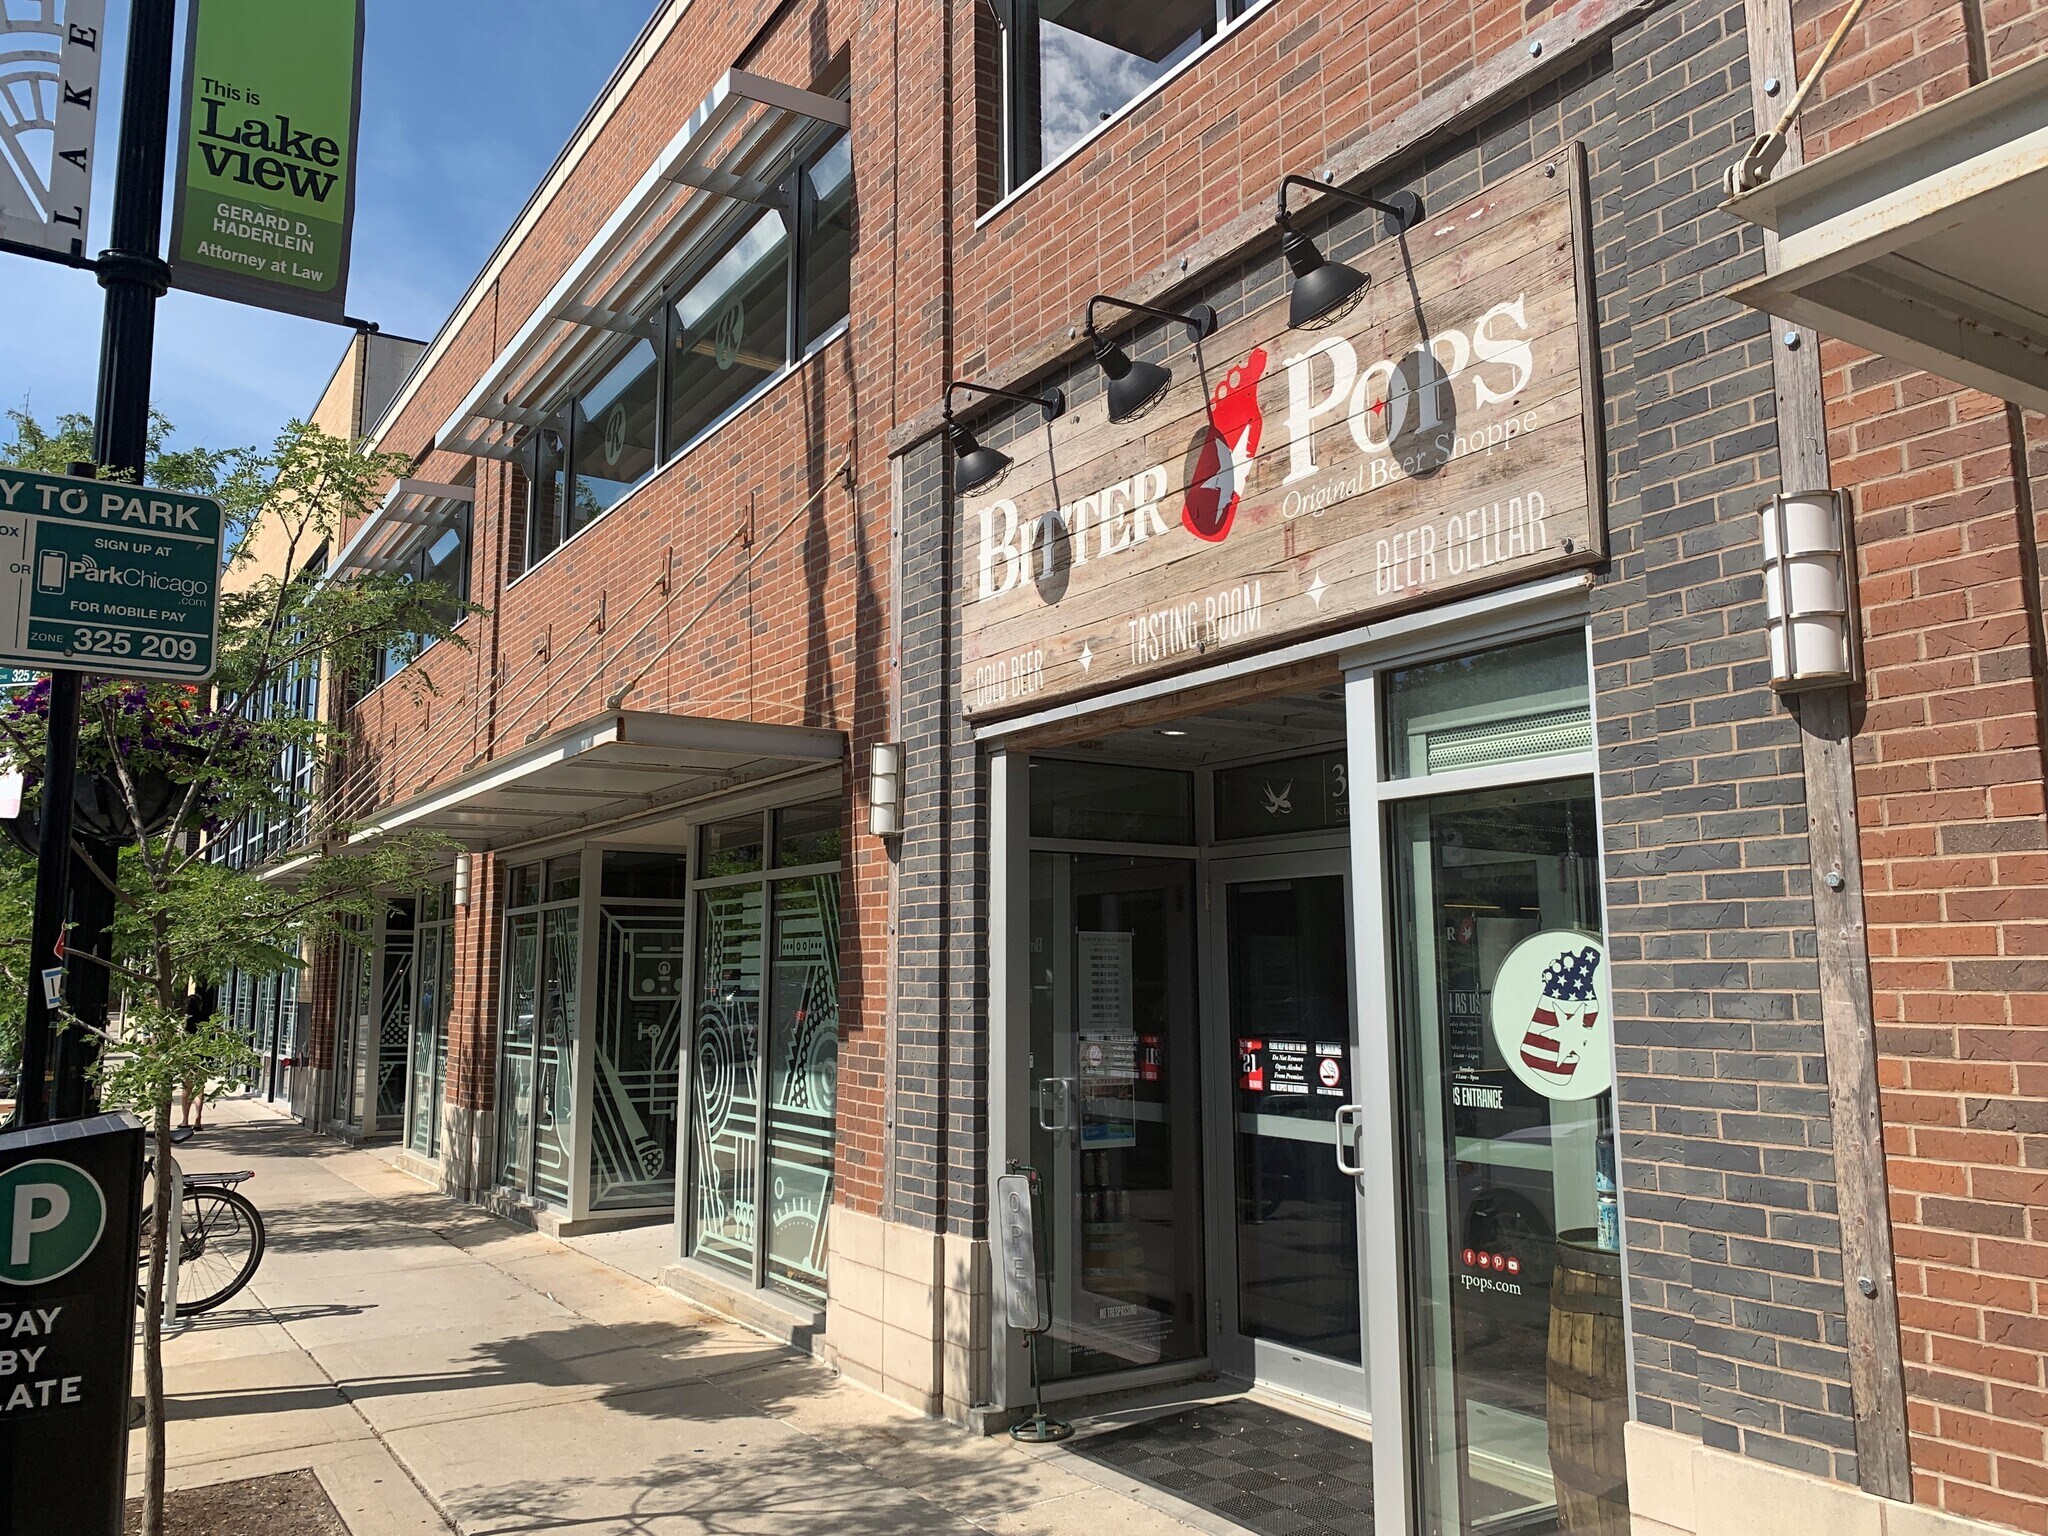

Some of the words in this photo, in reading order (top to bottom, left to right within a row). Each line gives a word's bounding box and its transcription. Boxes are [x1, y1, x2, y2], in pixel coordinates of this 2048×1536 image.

[201, 77, 241, 101] This
[246, 88, 260, 105] is
[199, 97, 339, 167] Lake
[198, 142, 338, 202] view
[213, 218, 314, 254] HADERLEIN
[216, 203, 289, 232] GERARD
[295, 222, 312, 238] D.
[198, 241, 266, 271] Attorney
[271, 259, 286, 274] at
[292, 263, 323, 282] Law
[977, 465, 1171, 604] BITTER
[1281, 293, 1534, 486] POPS
[1282, 475, 1364, 518] Original
[1370, 450, 1427, 489] Beer
[1435, 410, 1539, 466] Shoppe
[35, 484, 88, 514] TO
[100, 494, 200, 531] PARK
[94, 538, 129, 552] SIGN
[132, 543, 152, 554] UP
[155, 547, 172, 557] AT
[1376, 524, 1436, 596] BEER
[1447, 491, 1547, 576] CELLAR
[10, 563, 31, 575] OR
[69, 561, 208, 597] ParkChicago
[70, 600, 99, 614] FOR
[103, 604, 157, 620] MOBILE
[161, 610, 187, 623] PAY
[178, 597, 207, 608] .com
[1129, 602, 1199, 665] TASTING
[1205, 580, 1261, 643] ROOM
[31, 632, 64, 643] ZONE
[73, 628, 131, 655] 325
[141, 635, 197, 662] 209
[12, 669, 30, 682] 325
[976, 660, 1006, 707] COLD
[1011, 650, 1044, 698] BEER
[1455, 993, 1467, 1014] AS
[1243, 1053, 1257, 1072] 21
[1462, 1088, 1504, 1110] ENTRANCE
[10, 1183, 71, 1265] P
[1008, 1190, 1030, 1314] OPEN
[1461, 1274, 1521, 1295] rpops.com
[0, 1306, 62, 1338] PAY
[1099, 1308, 1106, 1319] NO
[1107, 1304, 1138, 1318] TRESPASSING
[0, 1346, 46, 1376] BY
[0, 1376, 82, 1411] ATE
